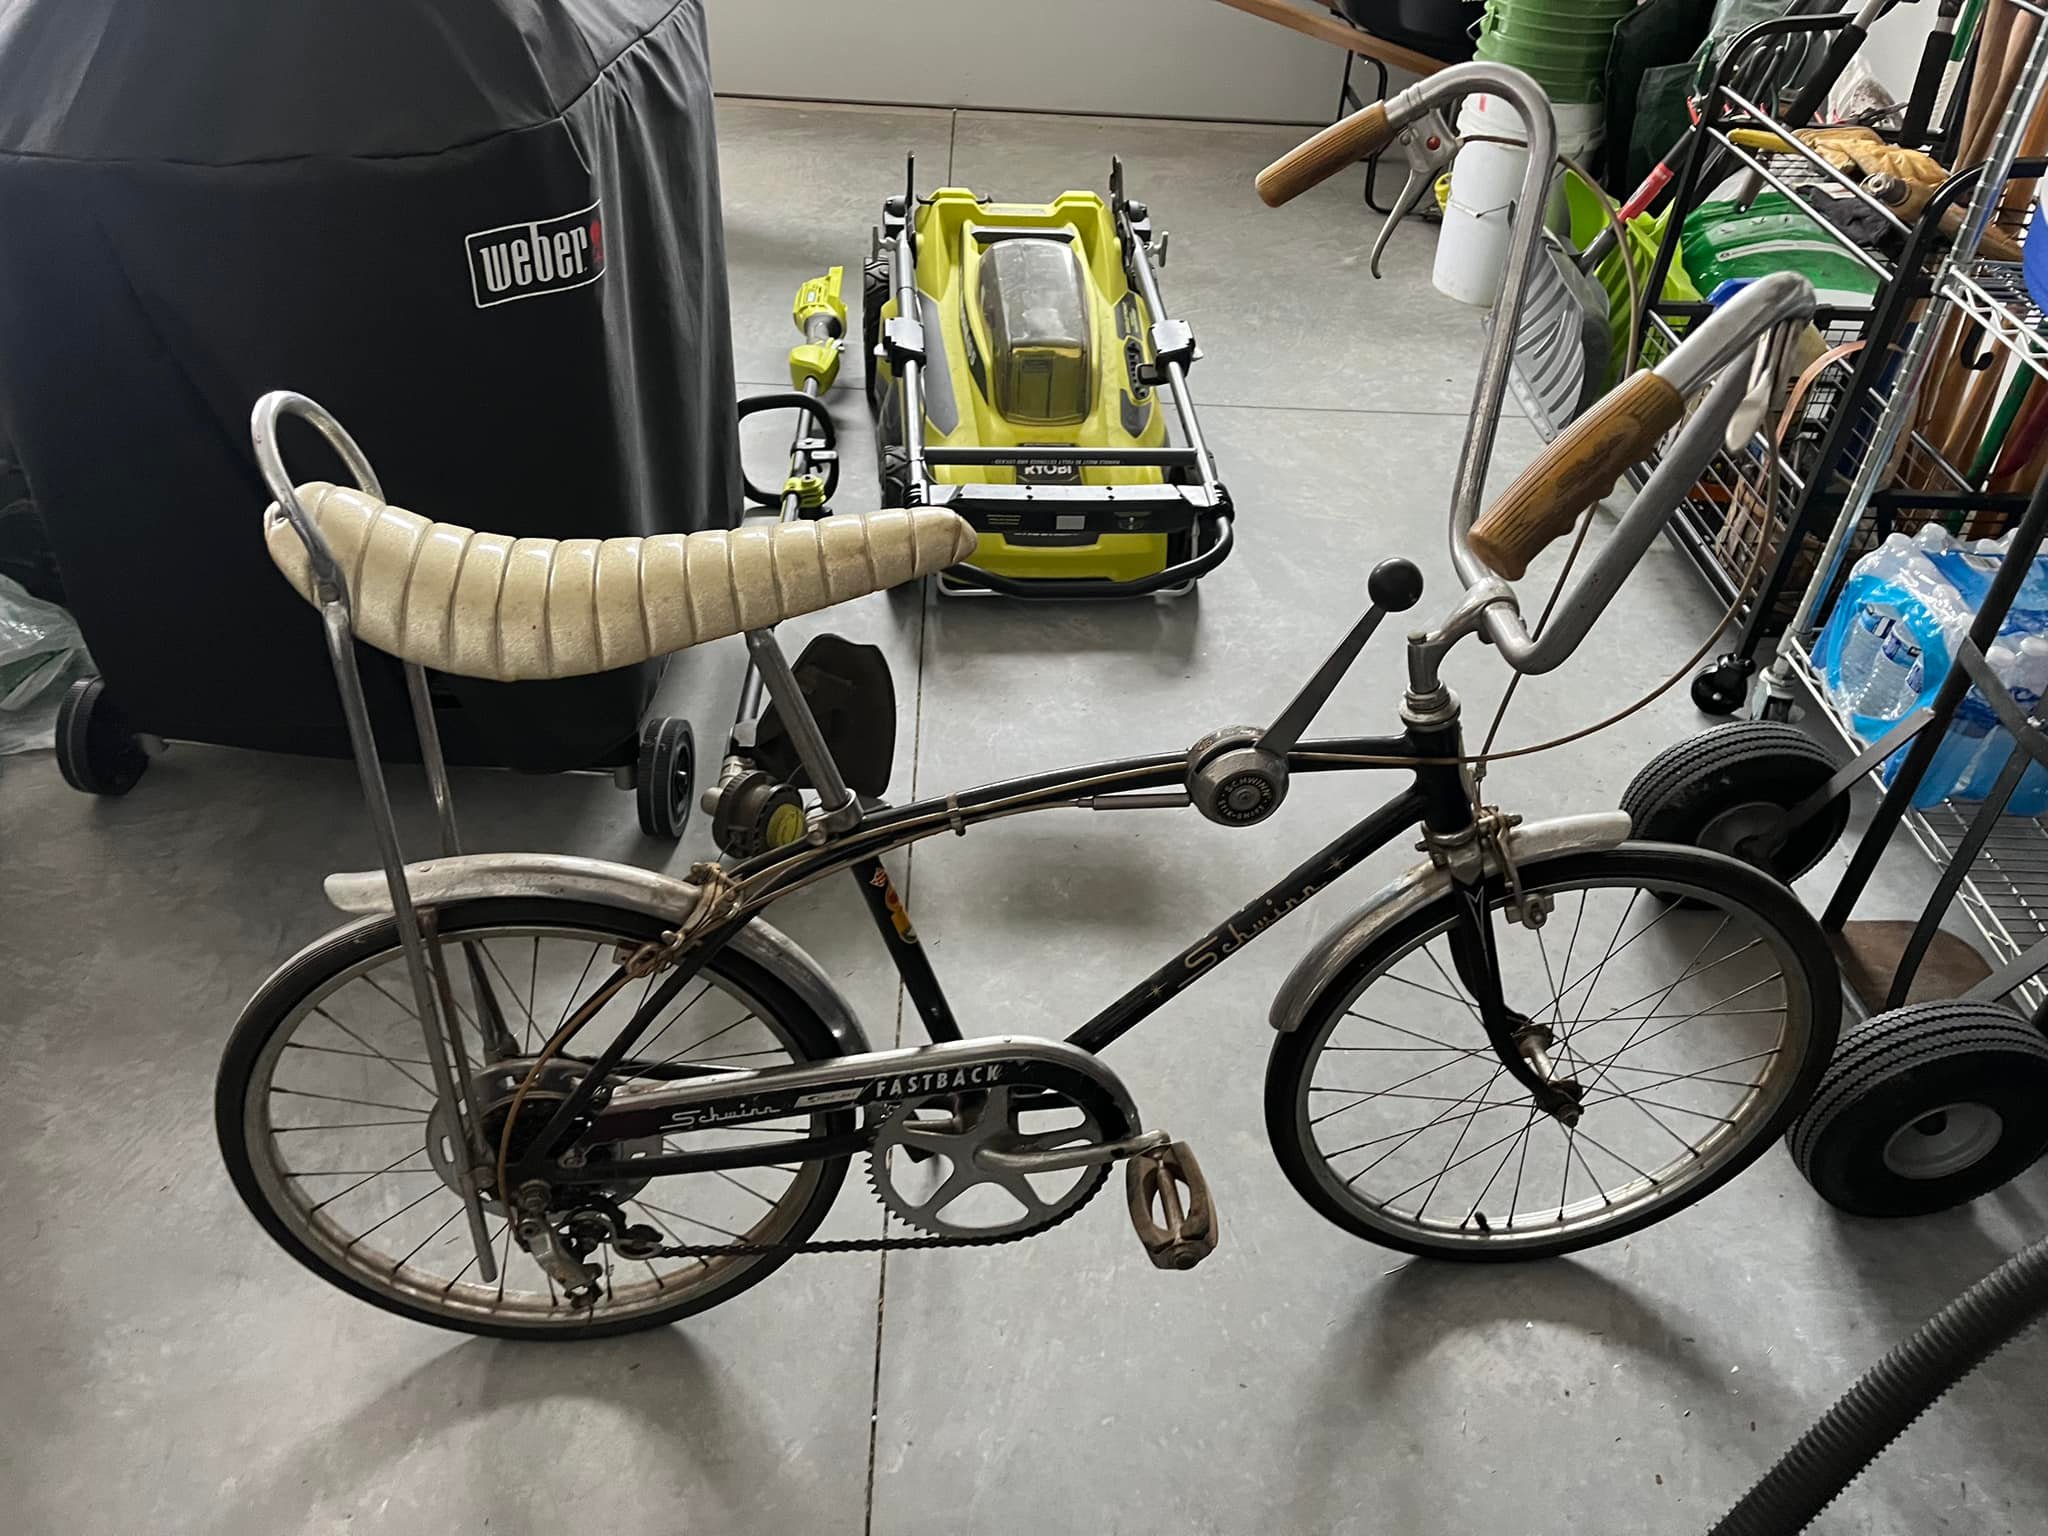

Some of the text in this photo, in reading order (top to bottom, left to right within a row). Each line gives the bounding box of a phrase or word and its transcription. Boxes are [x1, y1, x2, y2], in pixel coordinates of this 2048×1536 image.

[479, 222, 588, 292] weber
[1024, 465, 1072, 475] RYOBI
[1177, 881, 1328, 988] Schwinn
[876, 1063, 1000, 1098] FASTBACK
[659, 1103, 781, 1129] Schwinn
